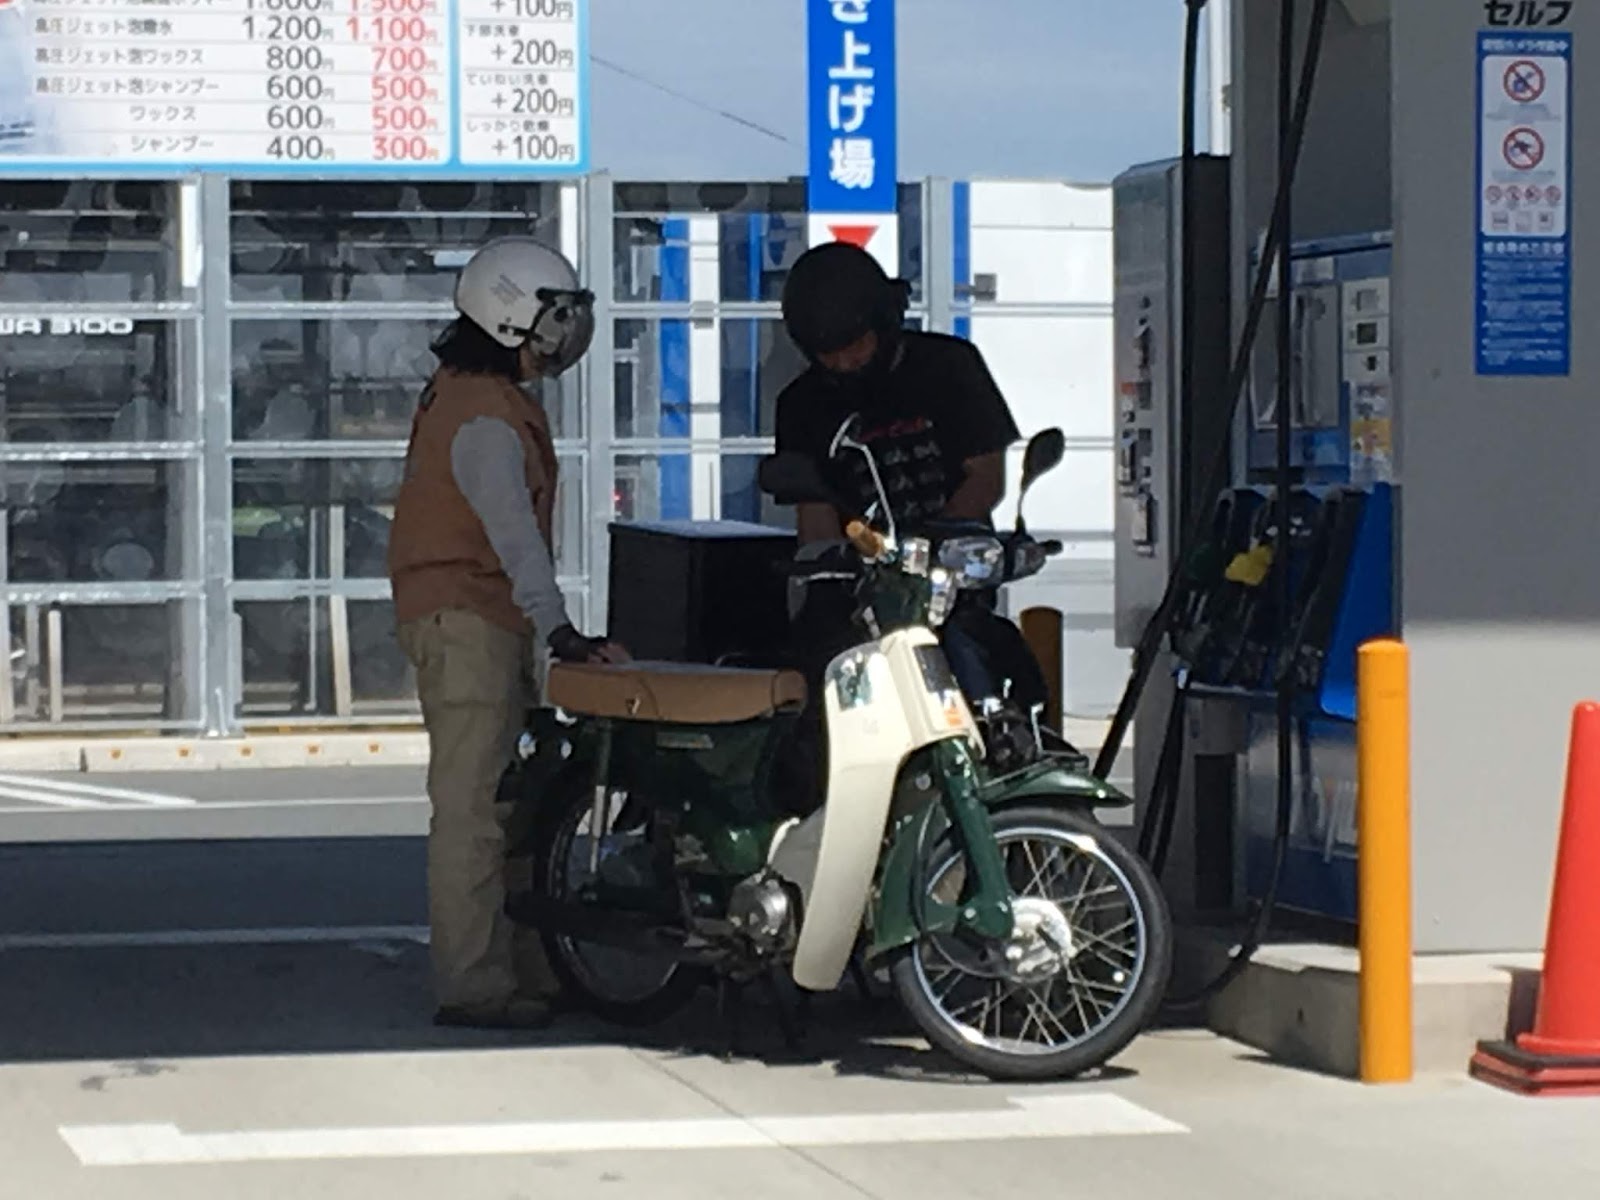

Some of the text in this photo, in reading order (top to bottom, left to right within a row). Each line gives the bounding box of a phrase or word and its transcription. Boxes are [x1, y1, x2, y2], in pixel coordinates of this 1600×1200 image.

[1485, 0, 1572, 26] セルフ
[266, 46, 334, 71] 800円
[371, 47, 438, 72] 700円
[266, 75, 334, 100] 600円
[371, 76, 438, 101] 500円
[129, 104, 438, 131] ワックス 600円 500円
[131, 135, 440, 160] シャンプー 400円 300円
